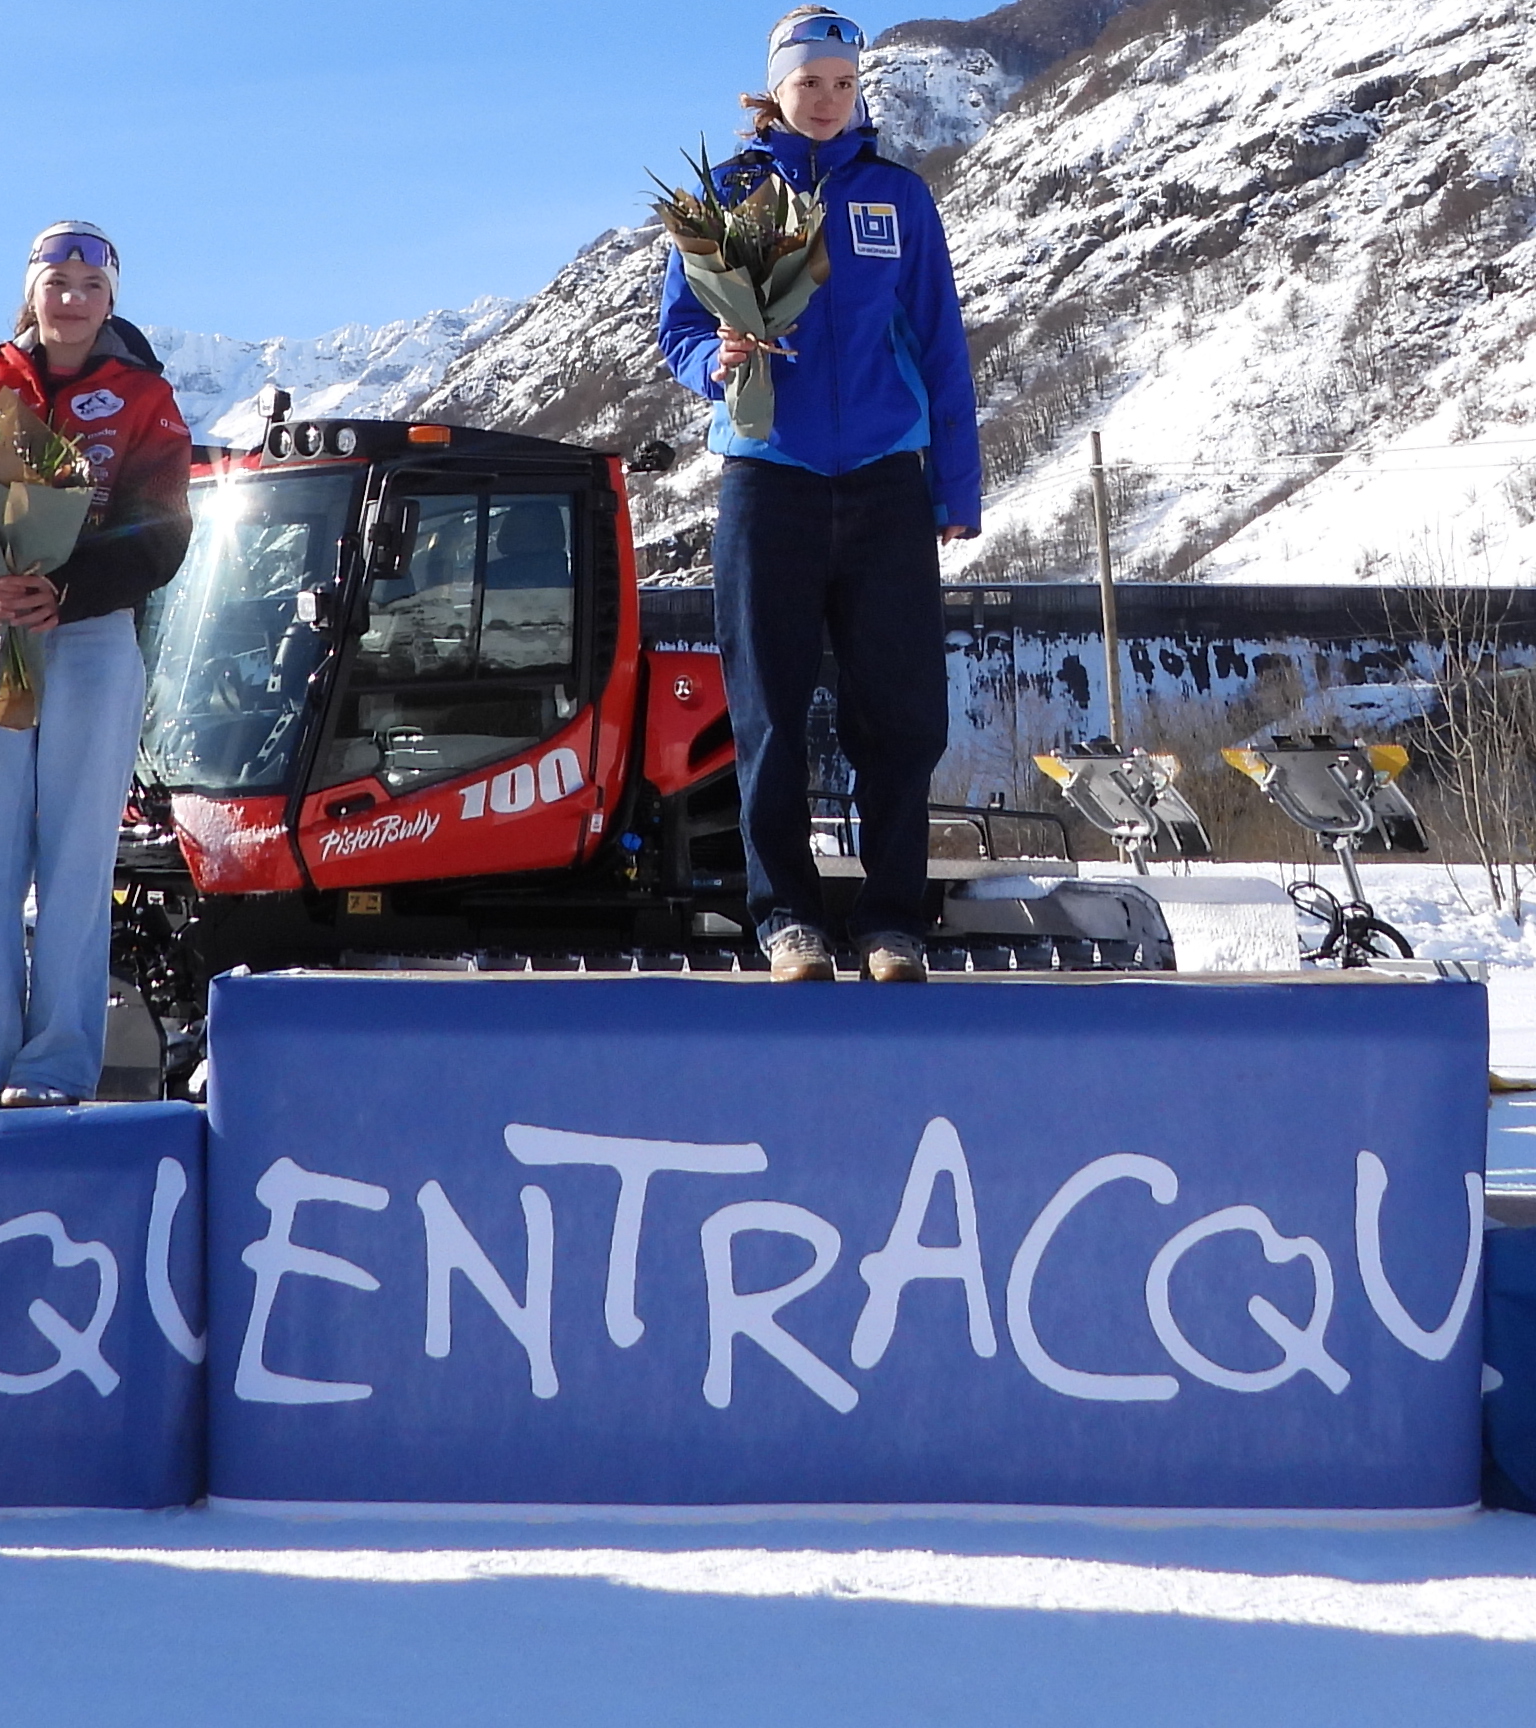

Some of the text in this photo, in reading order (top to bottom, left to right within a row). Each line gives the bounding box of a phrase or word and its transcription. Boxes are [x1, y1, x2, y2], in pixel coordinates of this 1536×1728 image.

[318, 747, 585, 862] PistenBully 100
[234, 1115, 1484, 1414] ENTRACQU
